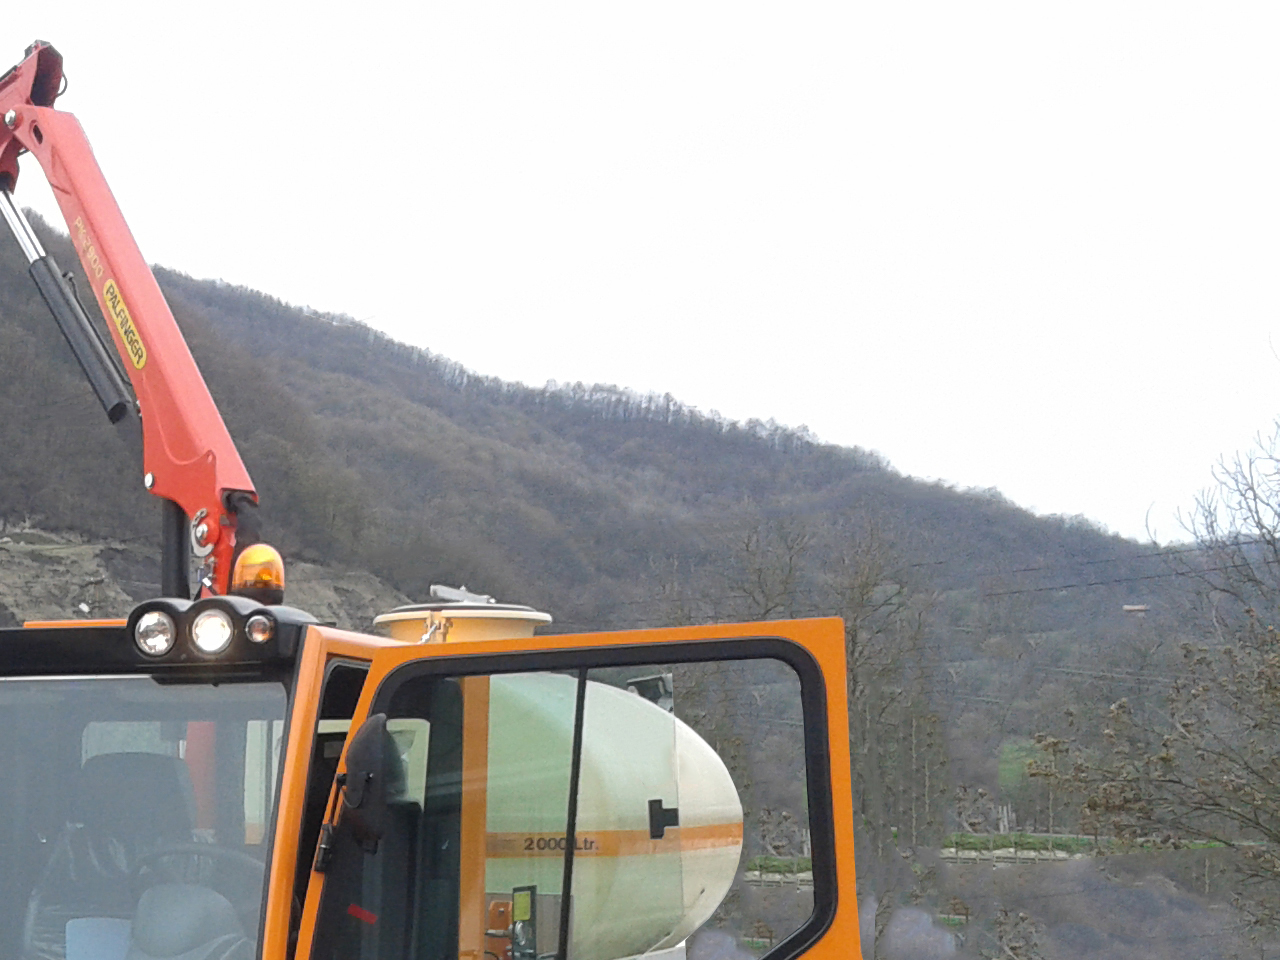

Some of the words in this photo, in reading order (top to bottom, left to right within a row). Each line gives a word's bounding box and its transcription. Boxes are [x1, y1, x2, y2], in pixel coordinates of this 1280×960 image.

[82, 236, 105, 279] 2900
[106, 282, 144, 365] PALFINGER
[523, 837, 568, 851] 2000
